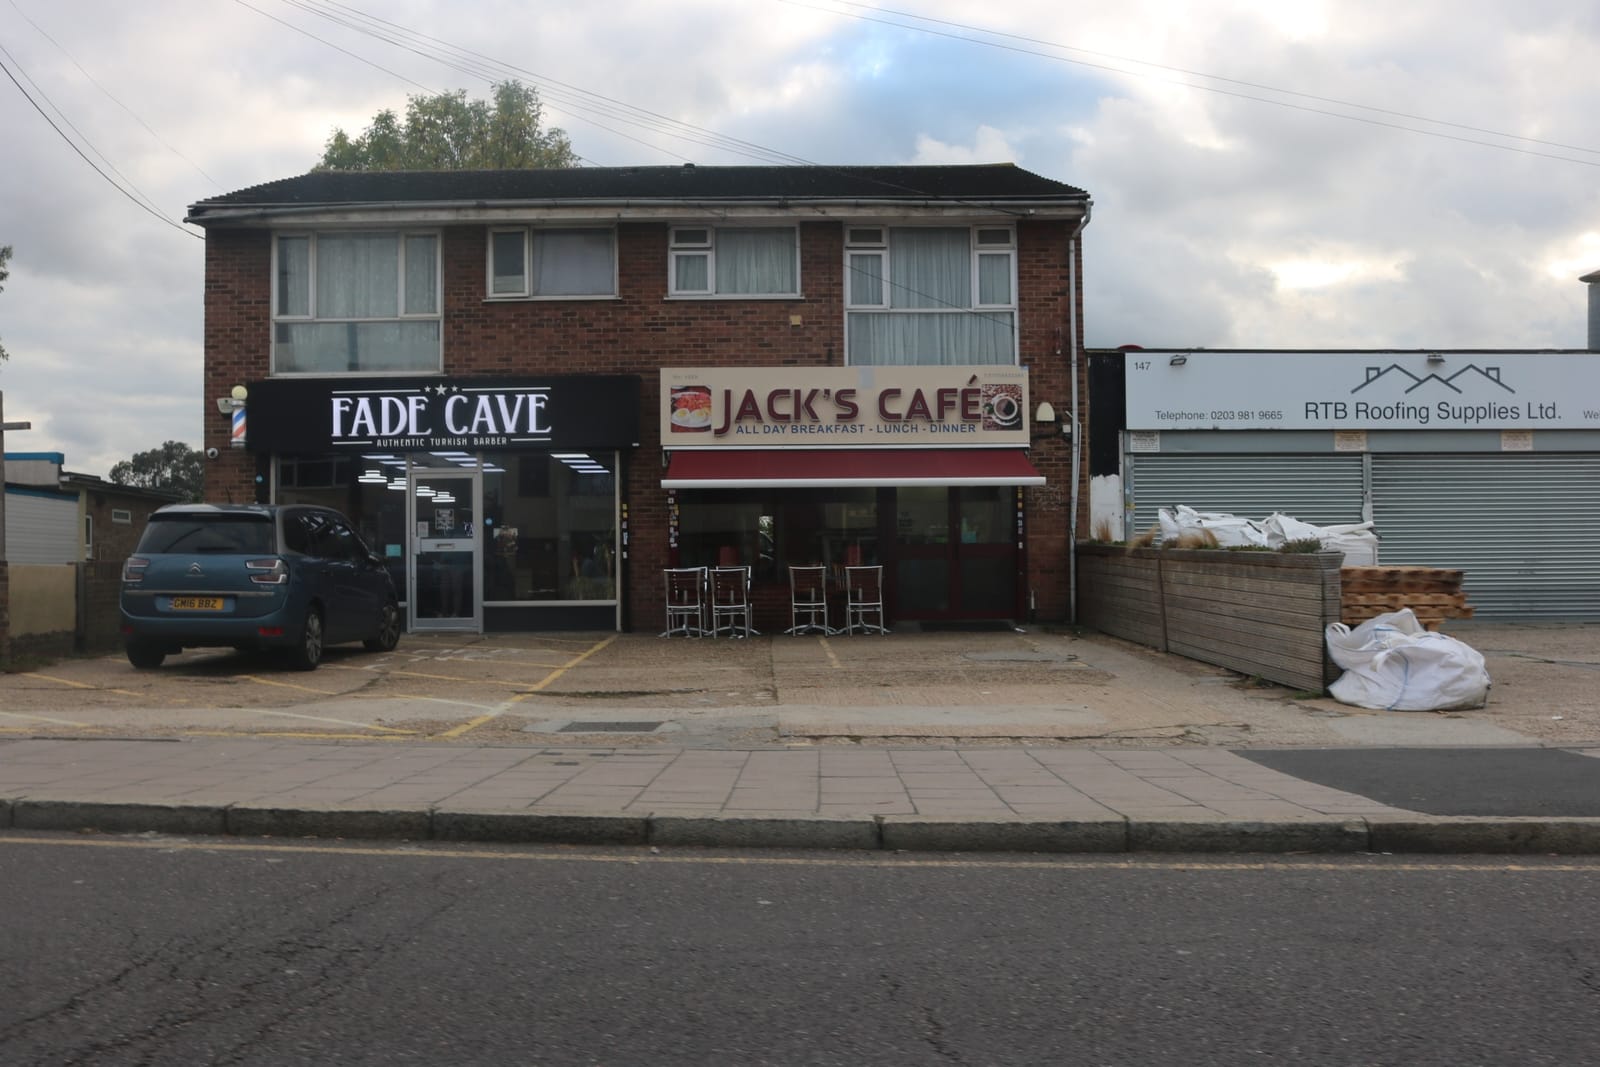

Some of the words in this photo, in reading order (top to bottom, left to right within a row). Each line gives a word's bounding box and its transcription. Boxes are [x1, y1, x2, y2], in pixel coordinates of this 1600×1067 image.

[1134, 361, 1151, 371] 147
[713, 388, 859, 437] JACK'S
[878, 373, 982, 422] CAFÉ
[331, 396, 432, 437] FADE
[444, 393, 552, 436] CAVE
[1155, 410, 1207, 422] Telephone:
[1210, 410, 1235, 420] 0203
[1237, 410, 1255, 420] 981
[1258, 410, 1283, 420] 9665
[1304, 401, 1348, 420] RTB
[1355, 400, 1430, 424] Roofing
[1436, 400, 1520, 424] Supplies
[1527, 401, 1562, 420] Ltd.
[1583, 409, 1600, 420] We
[736, 424, 759, 435] ALL
[763, 424, 788, 434] DAY
[791, 424, 865, 434] BREAKFAST
[876, 423, 919, 433] LUNCH
[930, 423, 976, 433] DINNER
[376, 438, 425, 448] AUTHENTIC
[430, 437, 468, 446] TURKISH
[473, 436, 507, 446] BARBER
